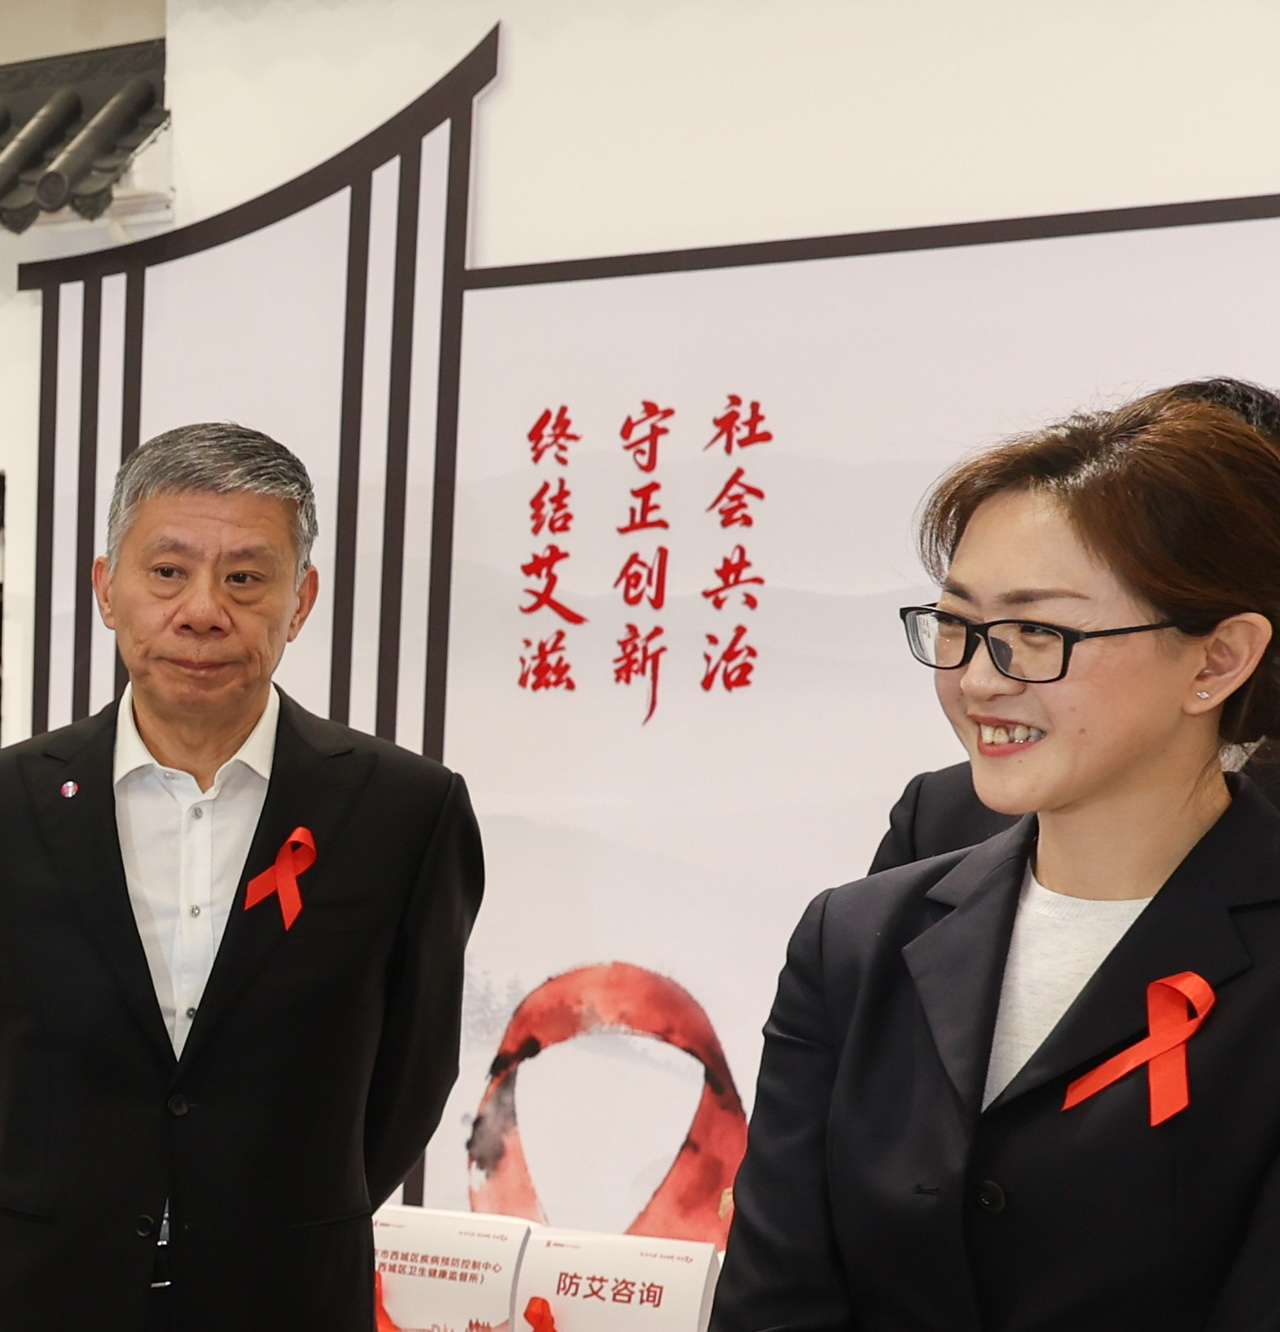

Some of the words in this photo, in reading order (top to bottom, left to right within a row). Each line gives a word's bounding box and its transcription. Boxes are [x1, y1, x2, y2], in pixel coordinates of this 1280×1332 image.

[518, 404, 589, 692] 终结艾滋
[612, 400, 675, 726] 守正创新
[700, 394, 773, 693] 社会共治
[556, 1272, 664, 1308] 防艾咨询
